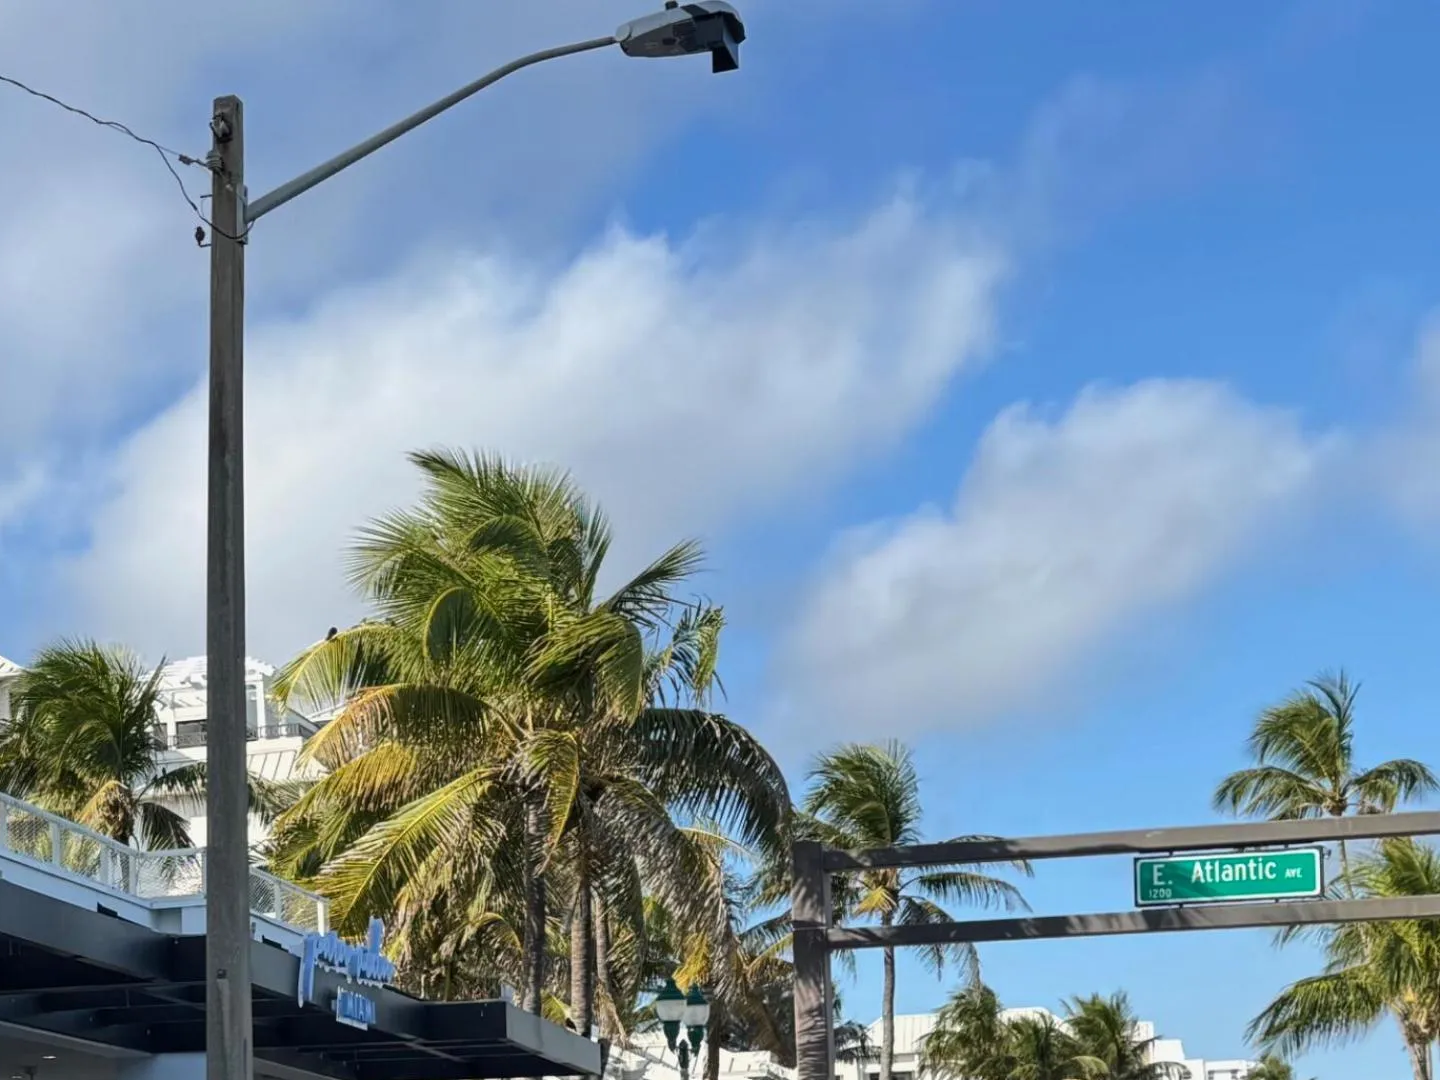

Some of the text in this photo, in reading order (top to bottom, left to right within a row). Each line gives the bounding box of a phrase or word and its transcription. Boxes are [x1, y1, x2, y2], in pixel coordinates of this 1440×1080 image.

[1153, 864, 1173, 886] E.
[1192, 858, 1276, 883] Atlantic
[1148, 887, 1172, 899] 1200
